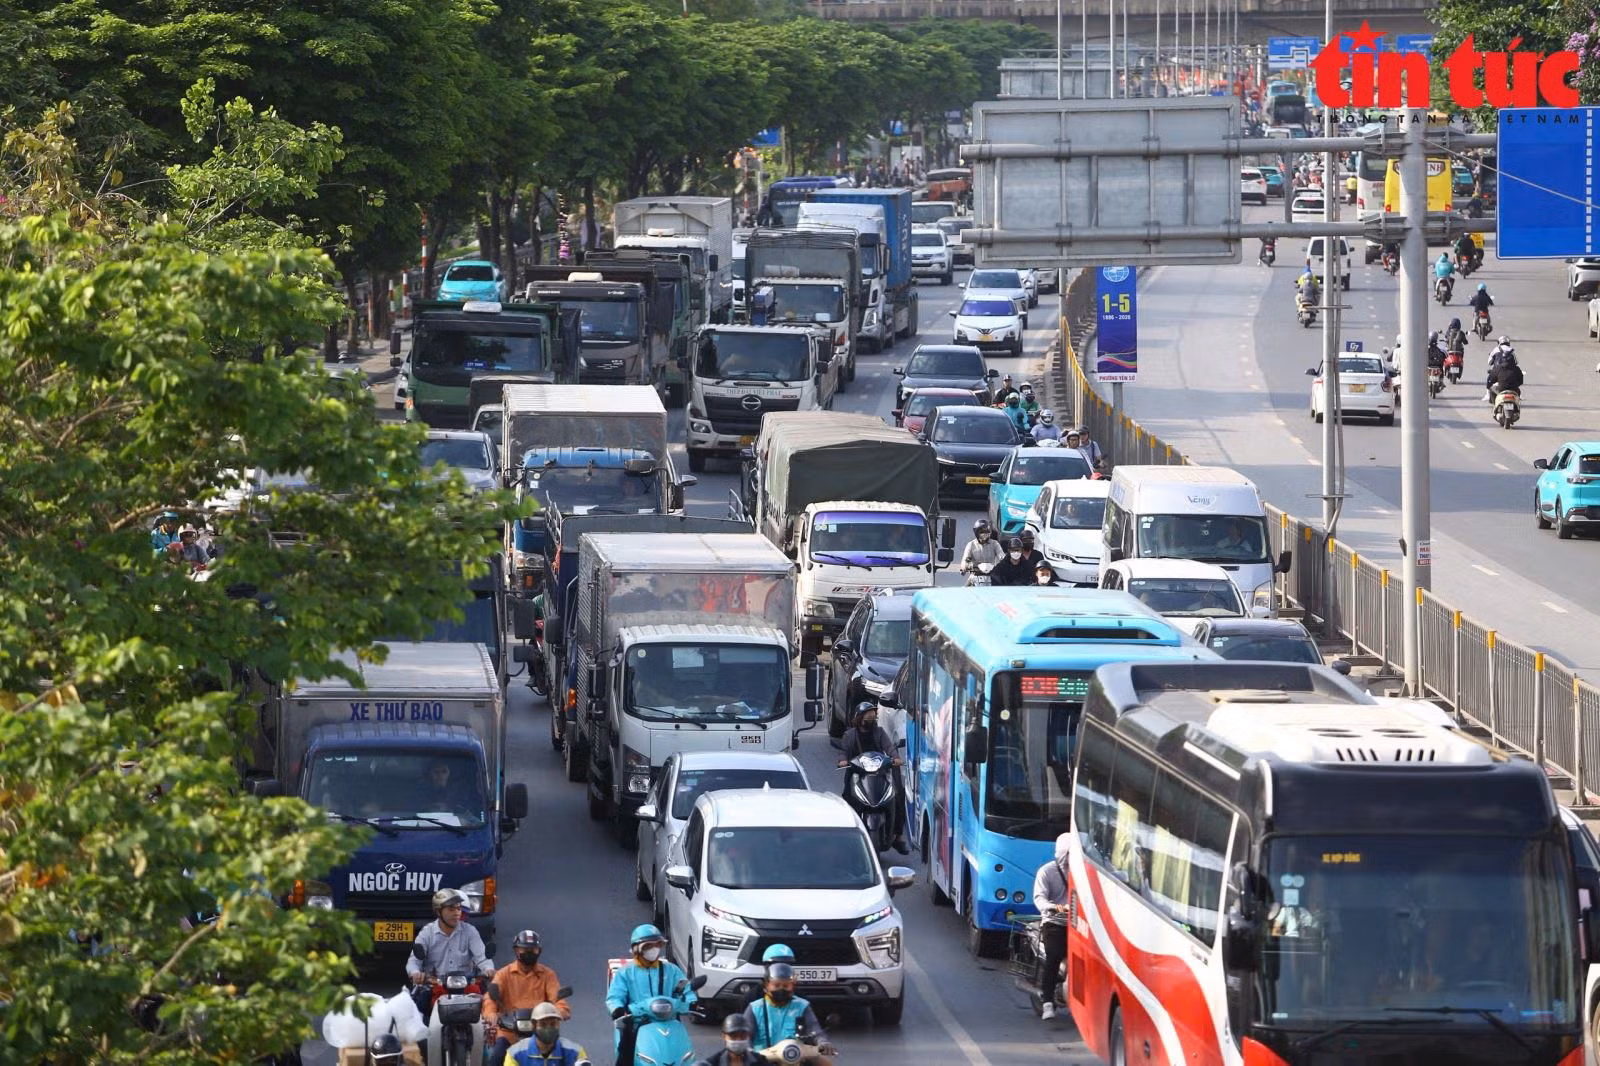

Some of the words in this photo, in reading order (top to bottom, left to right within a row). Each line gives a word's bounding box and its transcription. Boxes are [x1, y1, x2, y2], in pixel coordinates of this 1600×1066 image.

[1102, 293, 1130, 313] 1-5
[350, 702, 370, 721] XE
[375, 700, 407, 721] THƯ
[405, 872, 443, 892] HUY
[378, 931, 409, 940] 839.01
[386, 923, 403, 931] 29H
